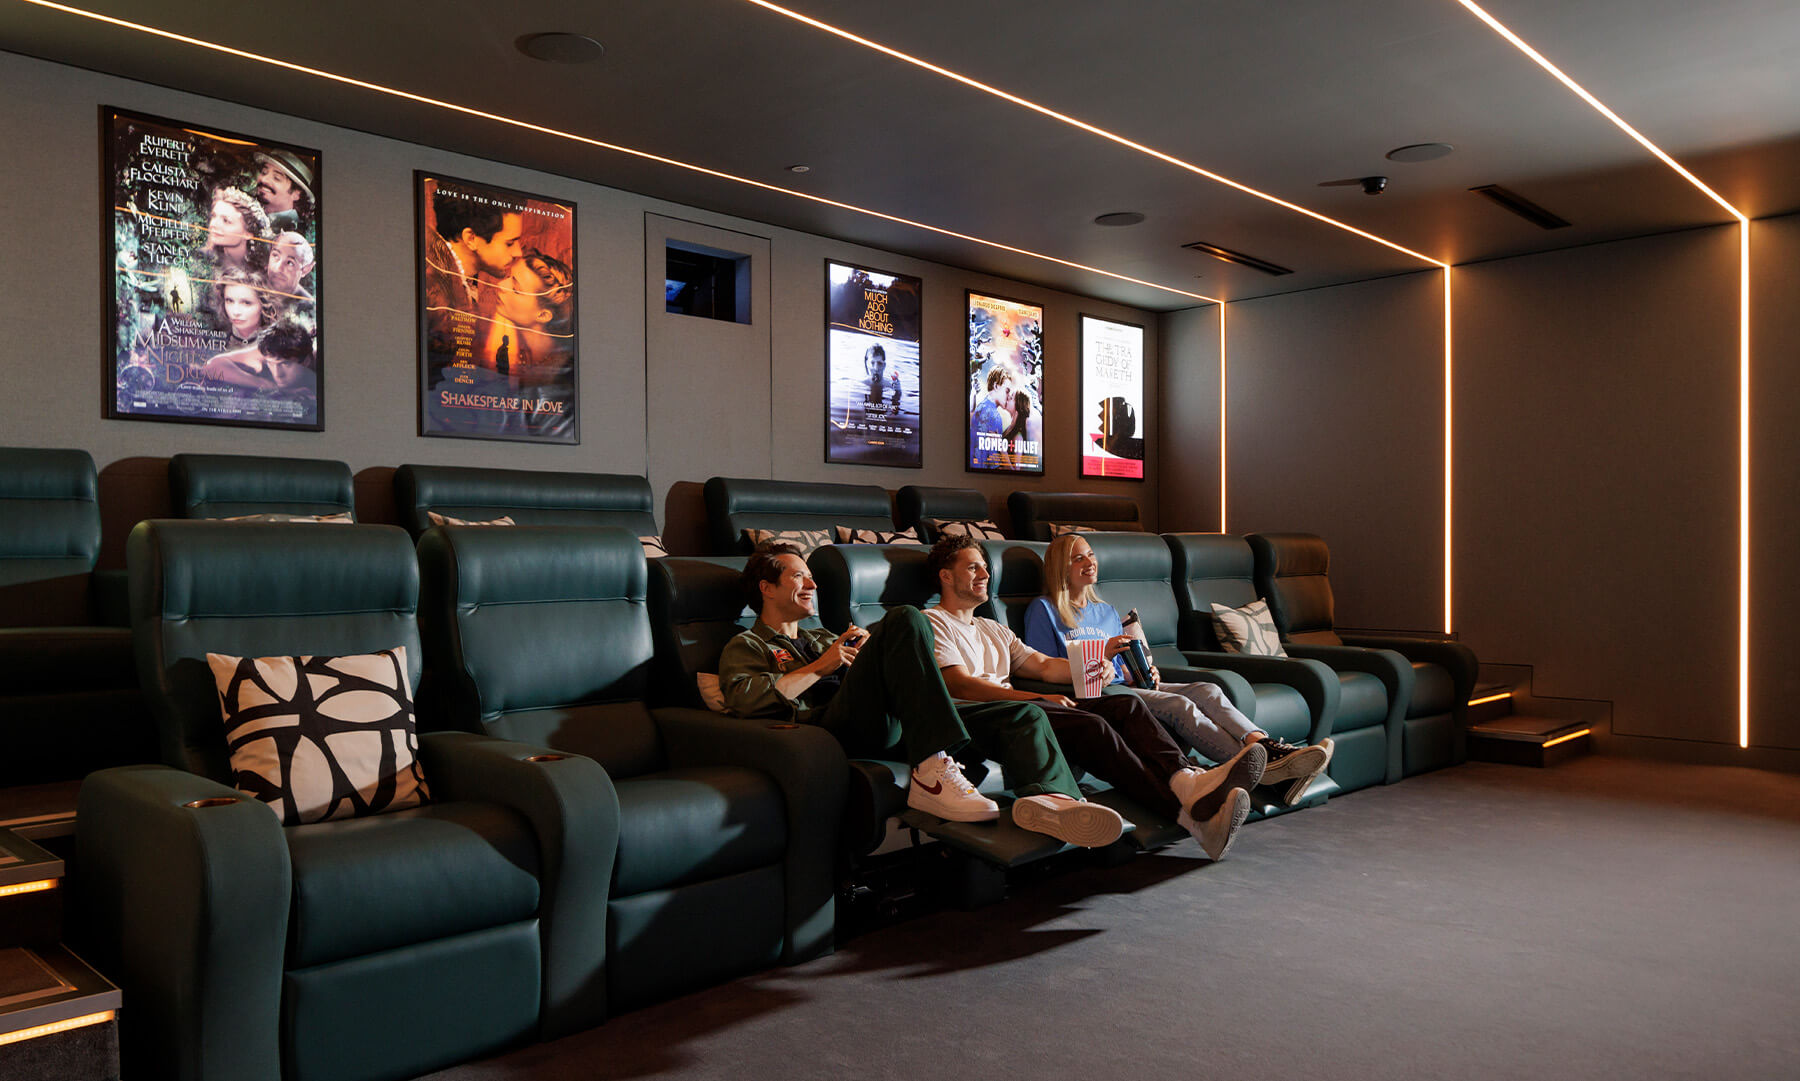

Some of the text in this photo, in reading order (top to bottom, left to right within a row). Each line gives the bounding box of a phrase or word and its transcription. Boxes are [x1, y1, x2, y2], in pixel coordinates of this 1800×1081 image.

[144, 134, 186, 151] RUPERT
[140, 142, 190, 162] EVERETT
[142, 161, 187, 178] CALISTA
[130, 167, 200, 190] FLOCKHART
[148, 188, 184, 203] KEVIN
[436, 188, 566, 219] LOVE IS THE ONLY INSPIRATION
[141, 223, 190, 241] PFEIFFER
[143, 241, 191, 257] STANLEY
[150, 252, 186, 267] TUCCI
[864, 290, 888, 304] MUCH
[867, 301, 886, 313] ADO
[171, 317, 203, 329] WILLIAM
[864, 310, 889, 323] ABOUT
[158, 318, 173, 335] A
[858, 318, 894, 334] NOTHING
[134, 328, 229, 351] MIDSUMMER
[440, 390, 564, 413] SHAKESPEARE IN LOVE
